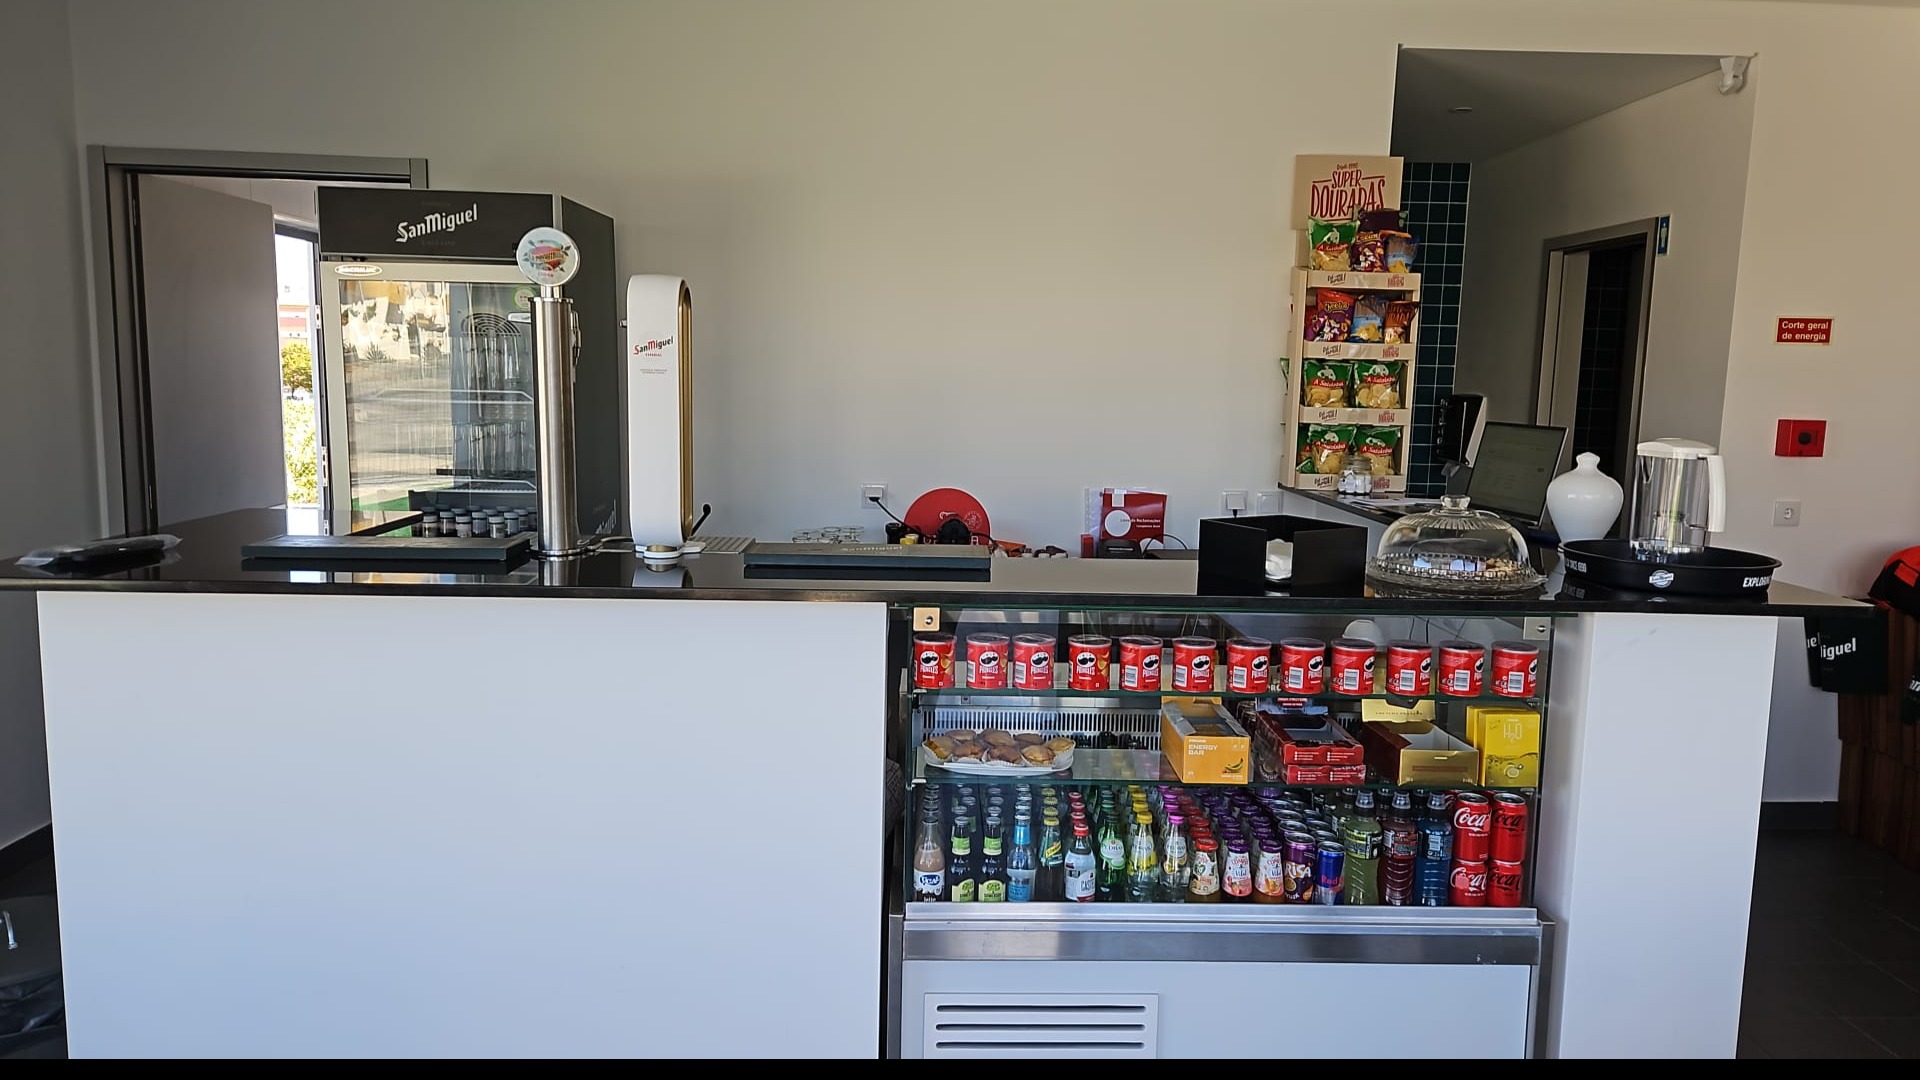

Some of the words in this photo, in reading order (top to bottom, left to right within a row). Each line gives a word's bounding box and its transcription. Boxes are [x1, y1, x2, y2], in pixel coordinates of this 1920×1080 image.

[1331, 169, 1362, 189] SUPER
[1310, 179, 1386, 219] DOURADAS
[1782, 320, 1805, 330] Corte
[1807, 321, 1829, 331] geral
[1781, 332, 1793, 340] de
[1795, 332, 1826, 342] energia
[1820, 637, 1857, 661] iguel
[920, 665, 939, 674] PRINGLES
[979, 665, 999, 674] PRINGLES
[1321, 874, 1338, 885] Red
